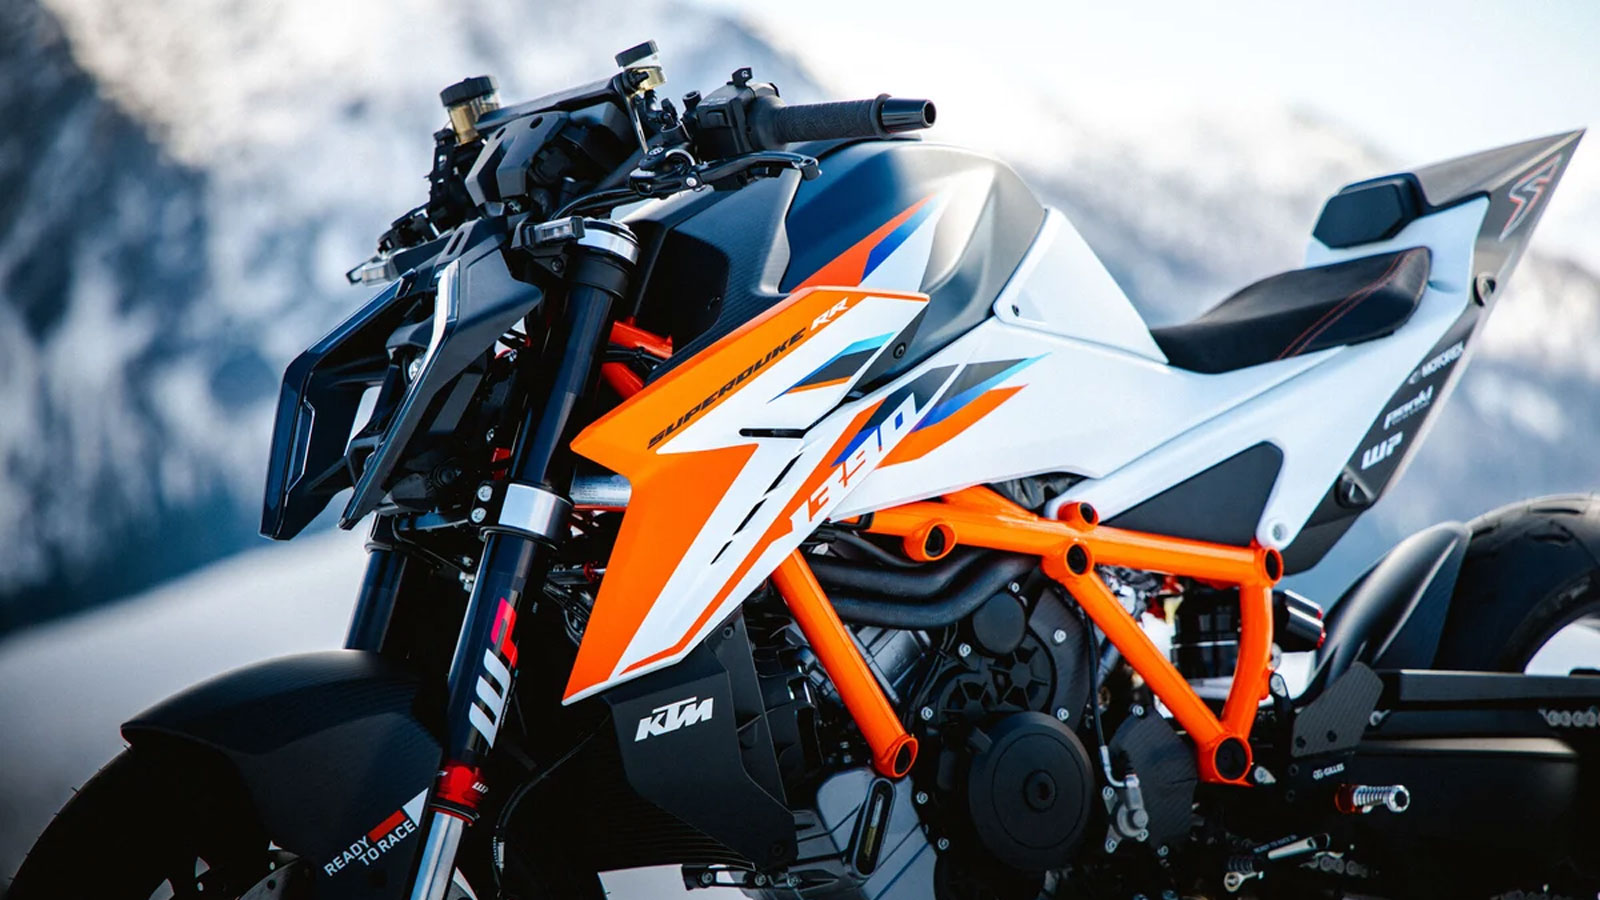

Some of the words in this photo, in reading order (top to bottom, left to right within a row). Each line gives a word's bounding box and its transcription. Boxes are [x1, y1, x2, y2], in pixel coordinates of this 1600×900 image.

[647, 327, 807, 450] SUPERDUKE
[810, 297, 849, 331] RR
[789, 392, 917, 541] 1390
[1361, 431, 1404, 470] WP
[468, 597, 519, 749] WP
[634, 696, 714, 742] KTM
[323, 835, 370, 877] READY
[358, 847, 380, 866] TO
[377, 819, 416, 853] RACE
